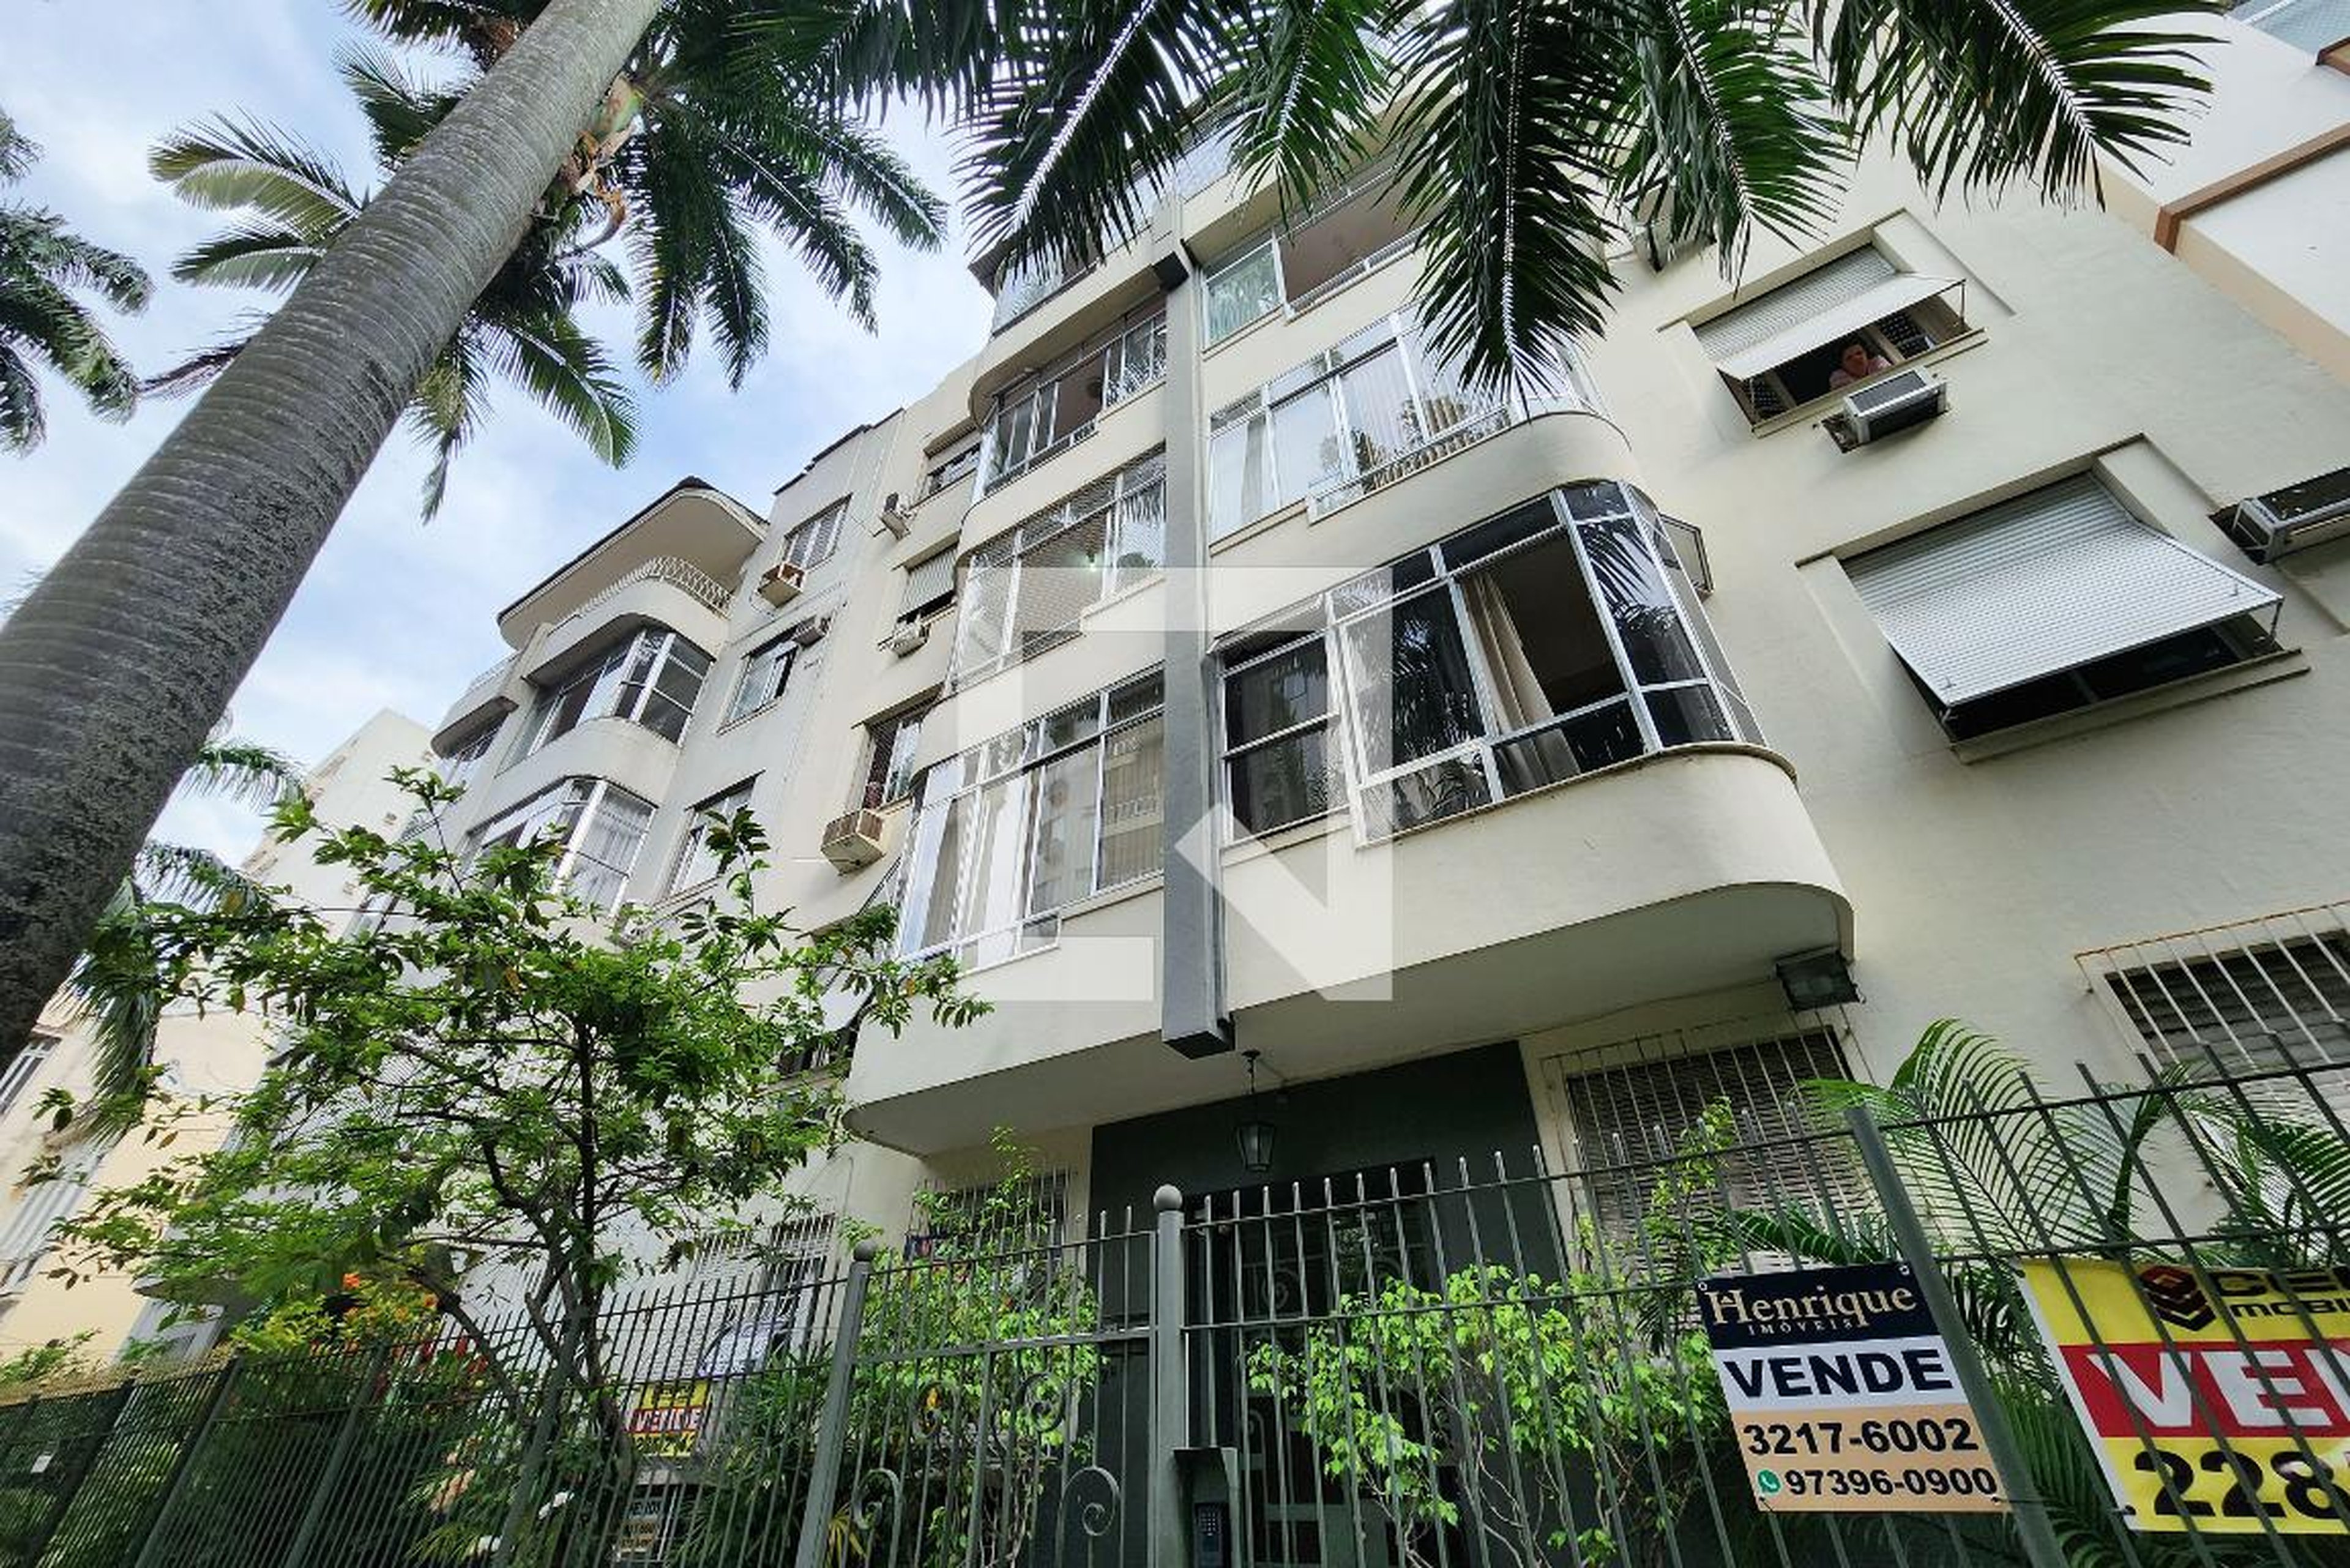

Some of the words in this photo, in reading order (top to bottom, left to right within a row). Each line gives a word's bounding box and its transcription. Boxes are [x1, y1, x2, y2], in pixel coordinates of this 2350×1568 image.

[1705, 1286, 1917, 1327] Henrique
[1723, 1349, 1953, 1398] VENDE
[1743, 1417, 1979, 1455] 3217-6002
[1785, 1468, 1997, 1495] 97396-0900
